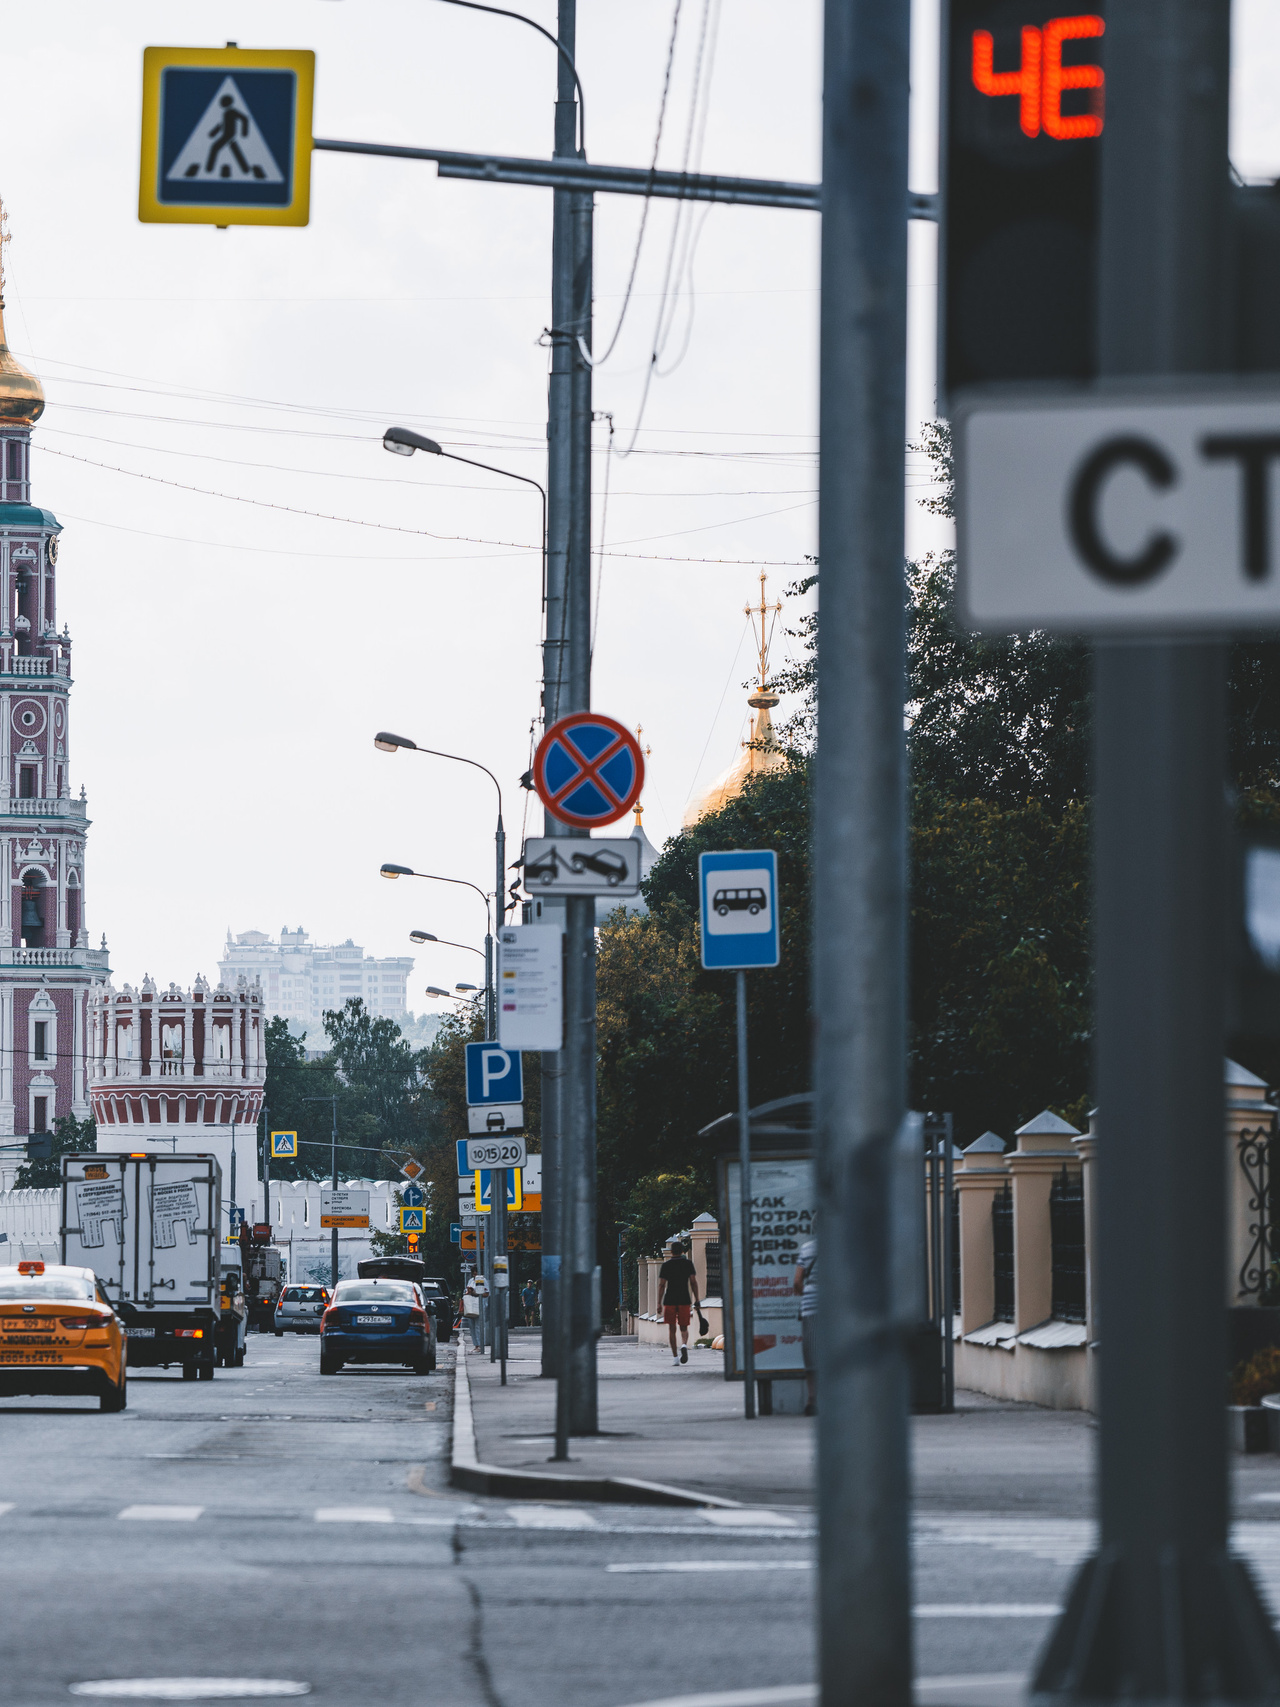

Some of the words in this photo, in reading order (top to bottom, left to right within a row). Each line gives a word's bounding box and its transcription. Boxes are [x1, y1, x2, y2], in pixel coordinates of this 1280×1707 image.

[481, 1049, 512, 1097] P
[473, 1149, 483, 1159] 10
[485, 1148, 498, 1159] 15
[501, 1146, 519, 1159] 20
[750, 1224, 815, 1236] РАБОЧ
[7, 1335, 52, 1345] MOMENTUM
